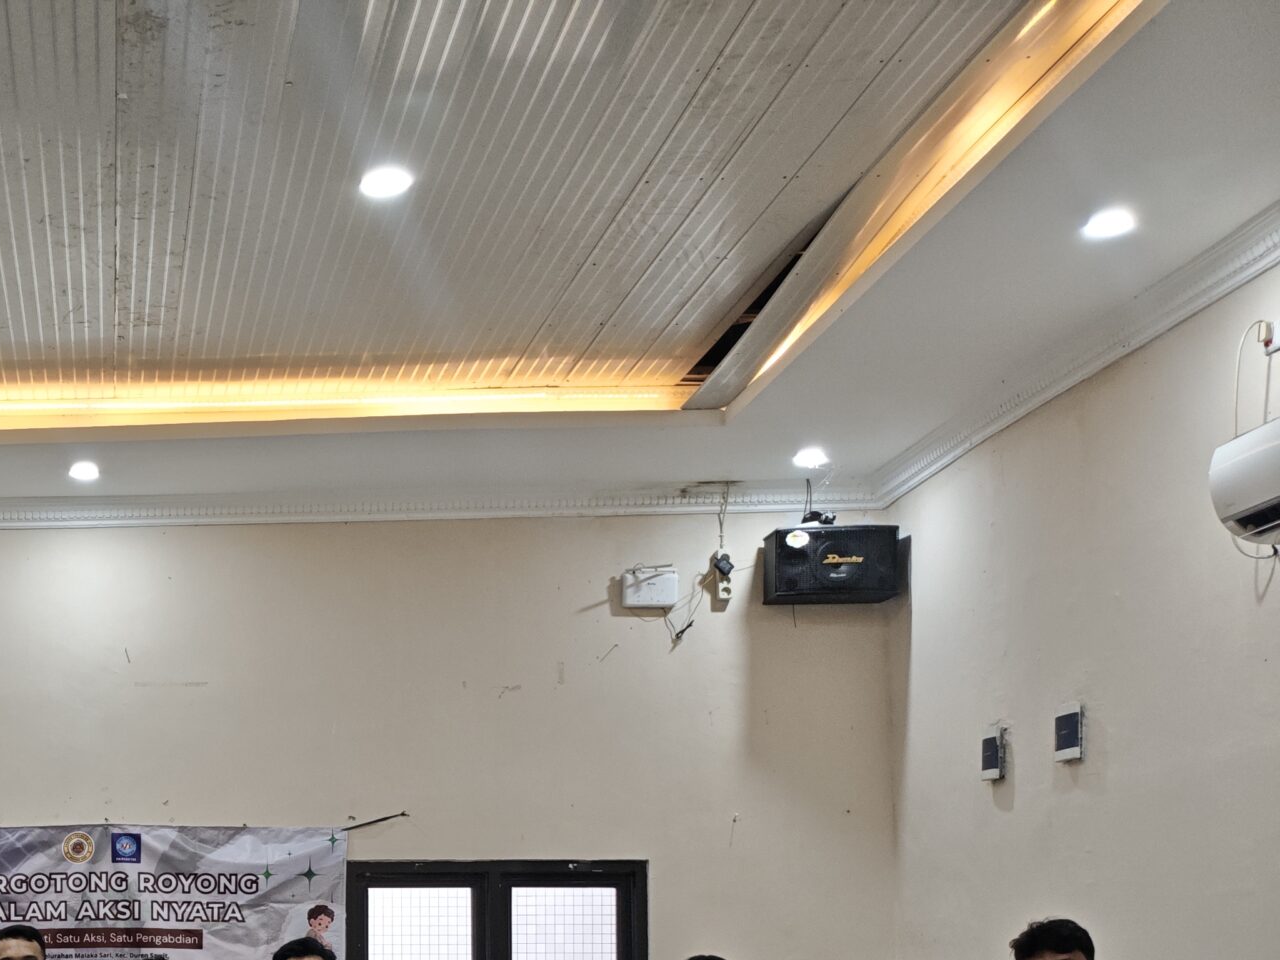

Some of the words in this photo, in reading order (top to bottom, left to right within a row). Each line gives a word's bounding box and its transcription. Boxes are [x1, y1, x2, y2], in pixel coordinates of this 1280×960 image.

[138, 872, 260, 895] ROYONG
[75, 900, 141, 922] AKSI
[151, 901, 246, 923] NYATA
[56, 933, 80, 944] Satu
[83, 933, 107, 945] Aksi,
[109, 932, 133, 943] Satu
[135, 933, 199, 946] Pengabdian
